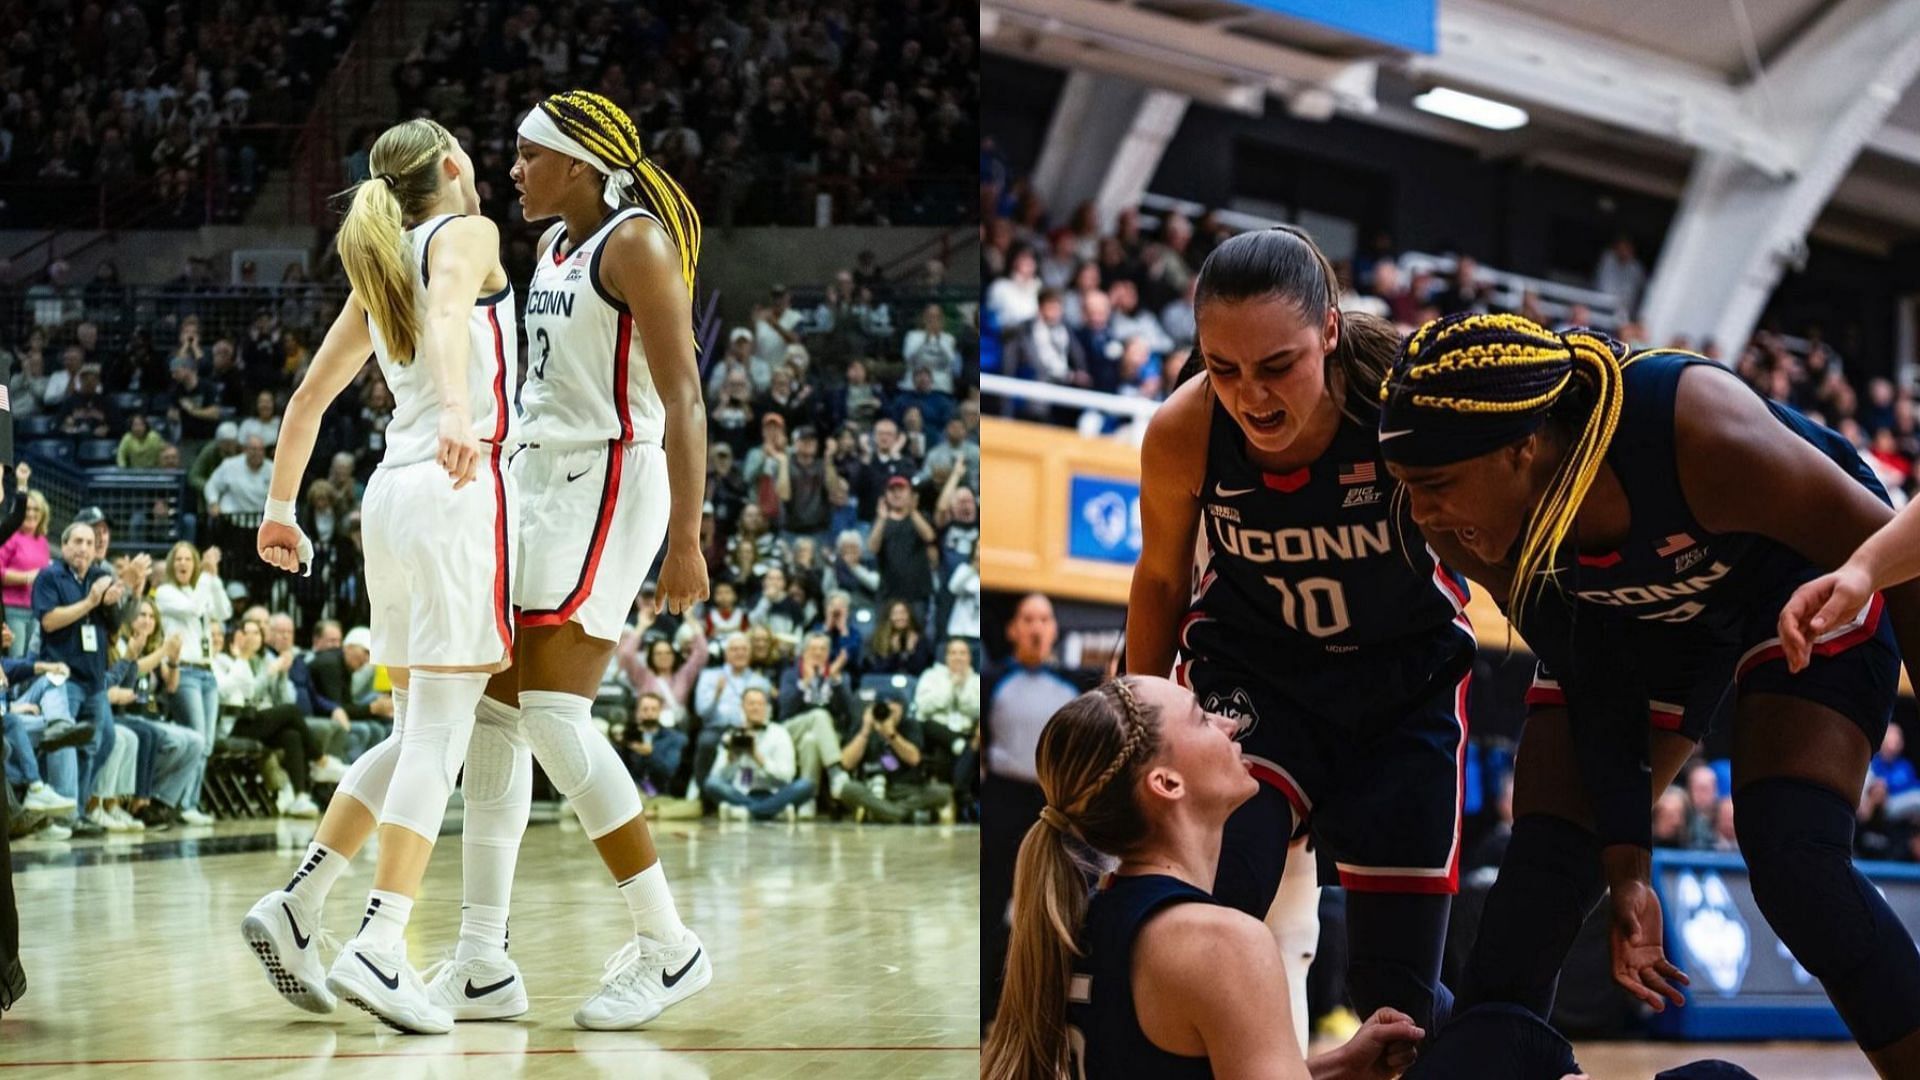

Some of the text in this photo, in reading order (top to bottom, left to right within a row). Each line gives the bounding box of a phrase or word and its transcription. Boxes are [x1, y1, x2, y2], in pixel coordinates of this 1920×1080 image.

[526, 290, 575, 317] CONN
[534, 327, 550, 380] 3
[1344, 492, 1383, 505] EAST
[1215, 517, 1392, 563] UCONN
[1569, 560, 1733, 606] CONN
[1264, 575, 1351, 638] 10
